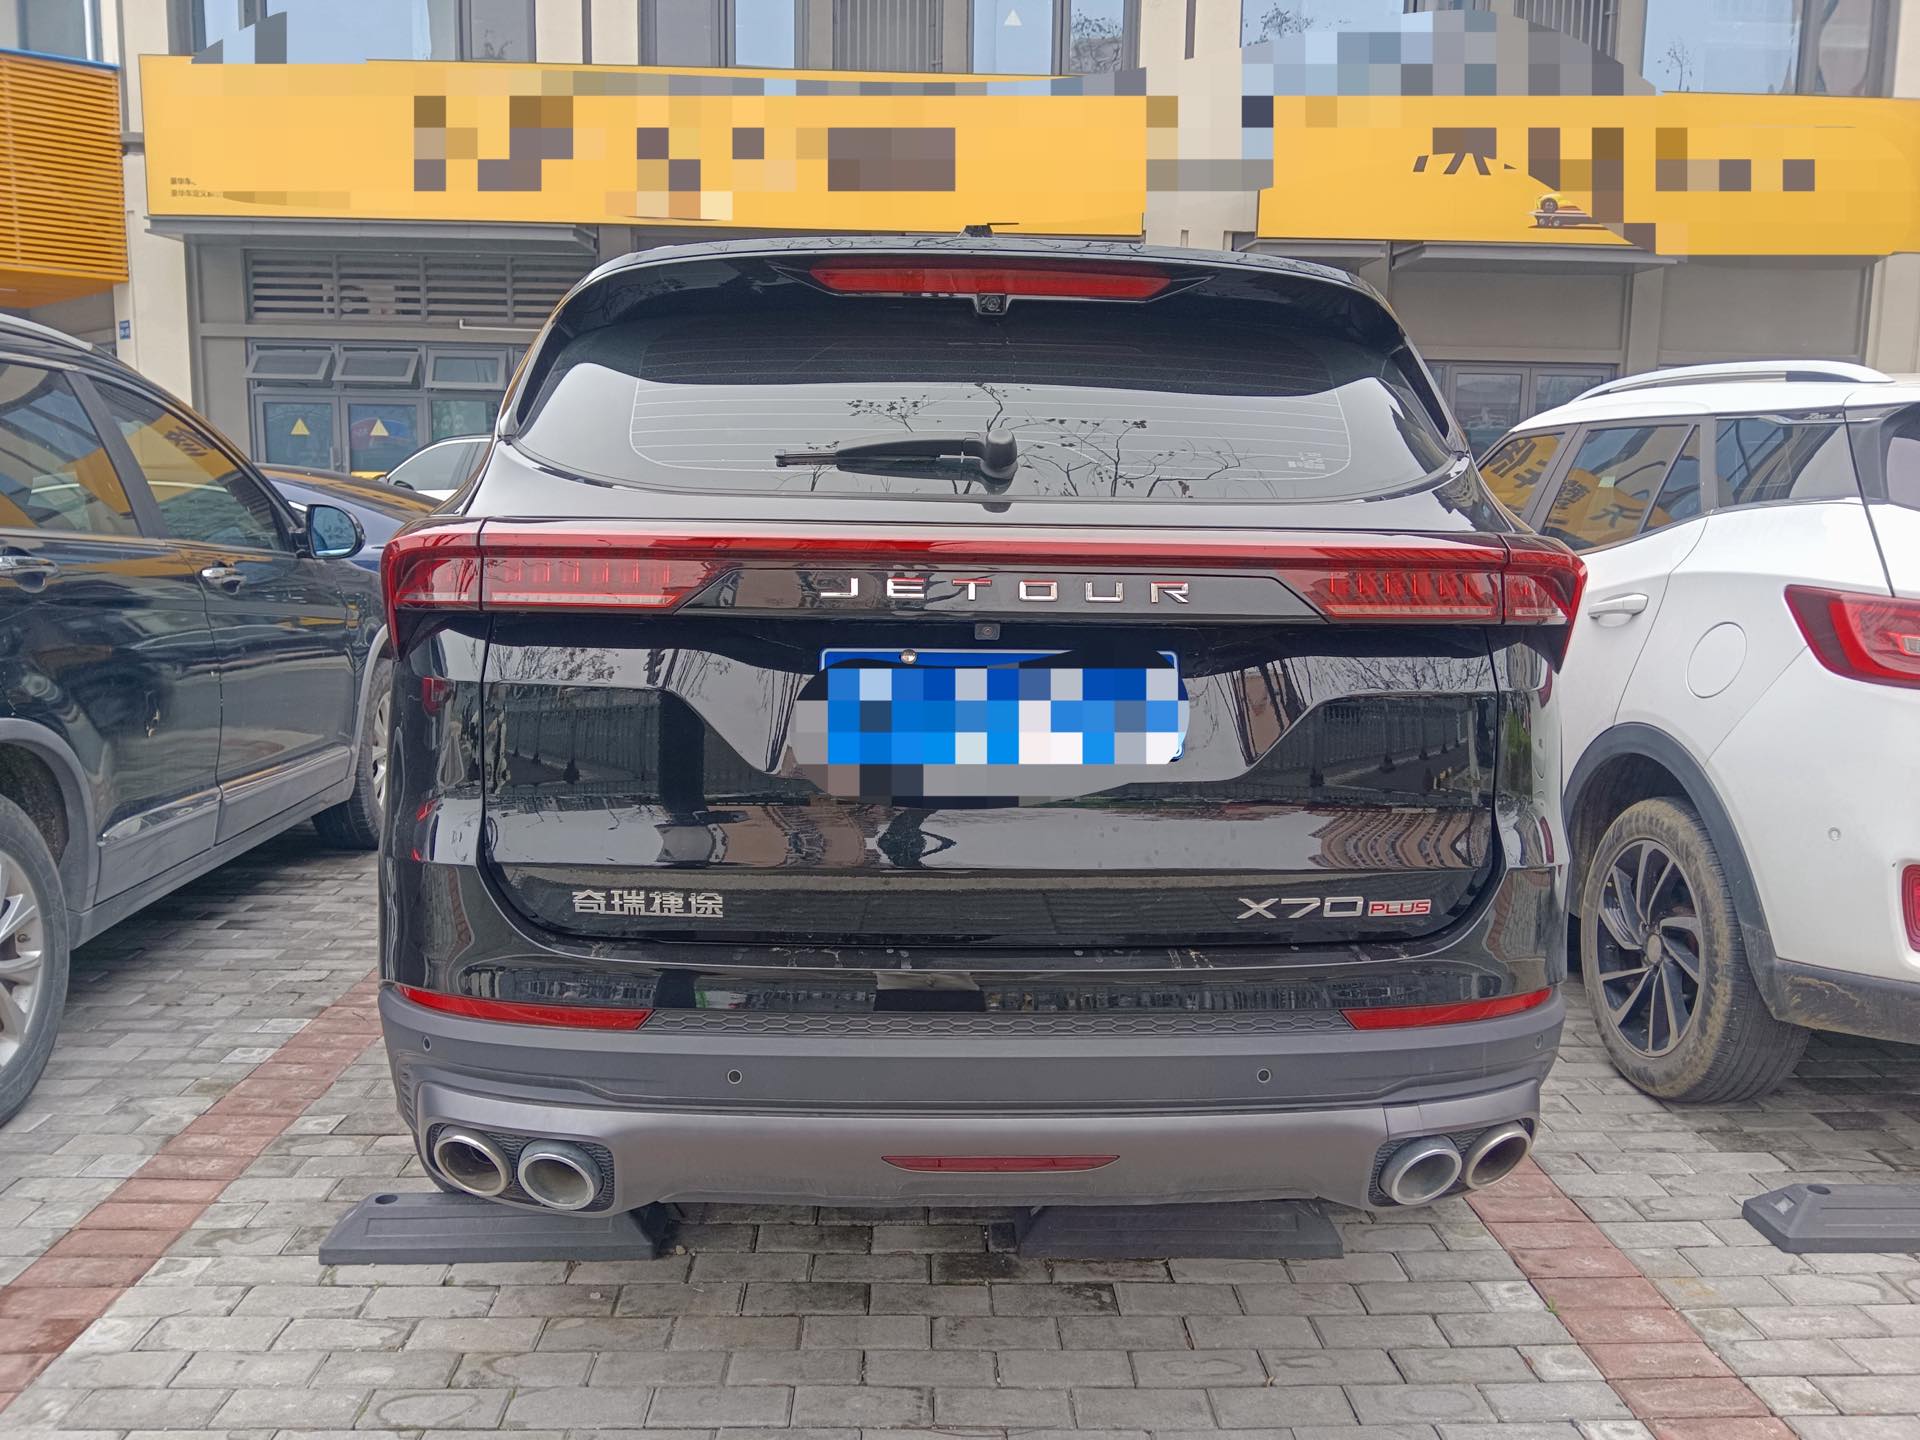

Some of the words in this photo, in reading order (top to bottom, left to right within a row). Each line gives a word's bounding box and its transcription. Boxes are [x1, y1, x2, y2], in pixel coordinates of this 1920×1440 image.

[820, 577, 1190, 604] JETOUR
[572, 889, 724, 918] 奇瑞捷途
[1236, 897, 1364, 919] X70
[1369, 899, 1430, 915] PLUS
